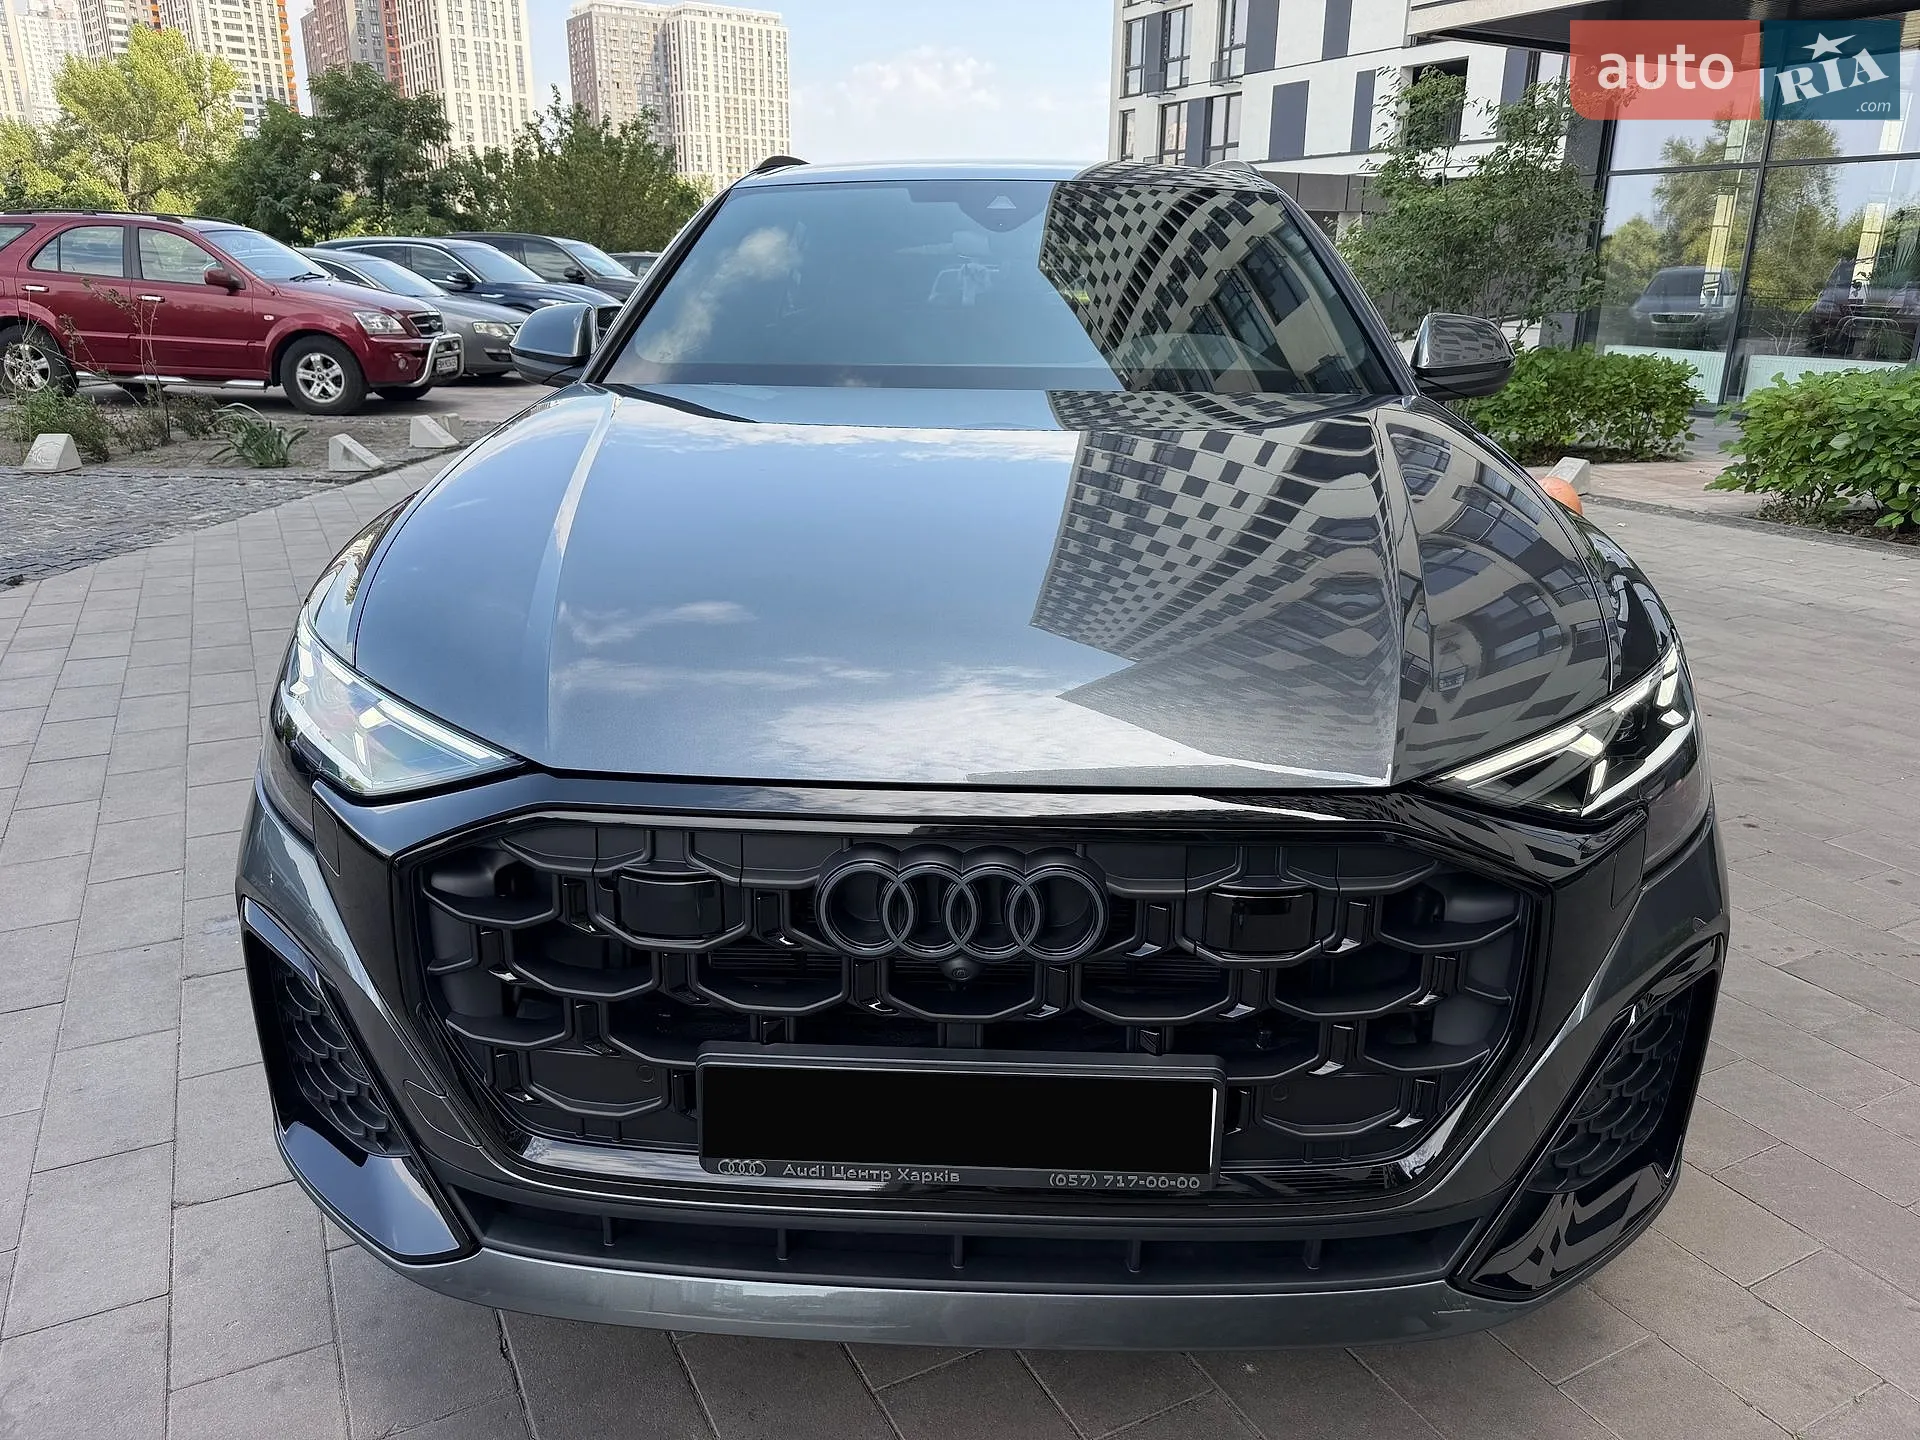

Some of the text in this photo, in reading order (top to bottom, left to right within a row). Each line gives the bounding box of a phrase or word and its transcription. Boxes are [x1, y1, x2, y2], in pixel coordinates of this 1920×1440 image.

[782, 1163, 961, 1184] Audi Центр Харків
[1049, 1173, 1200, 1189] (057) 717-00-00
